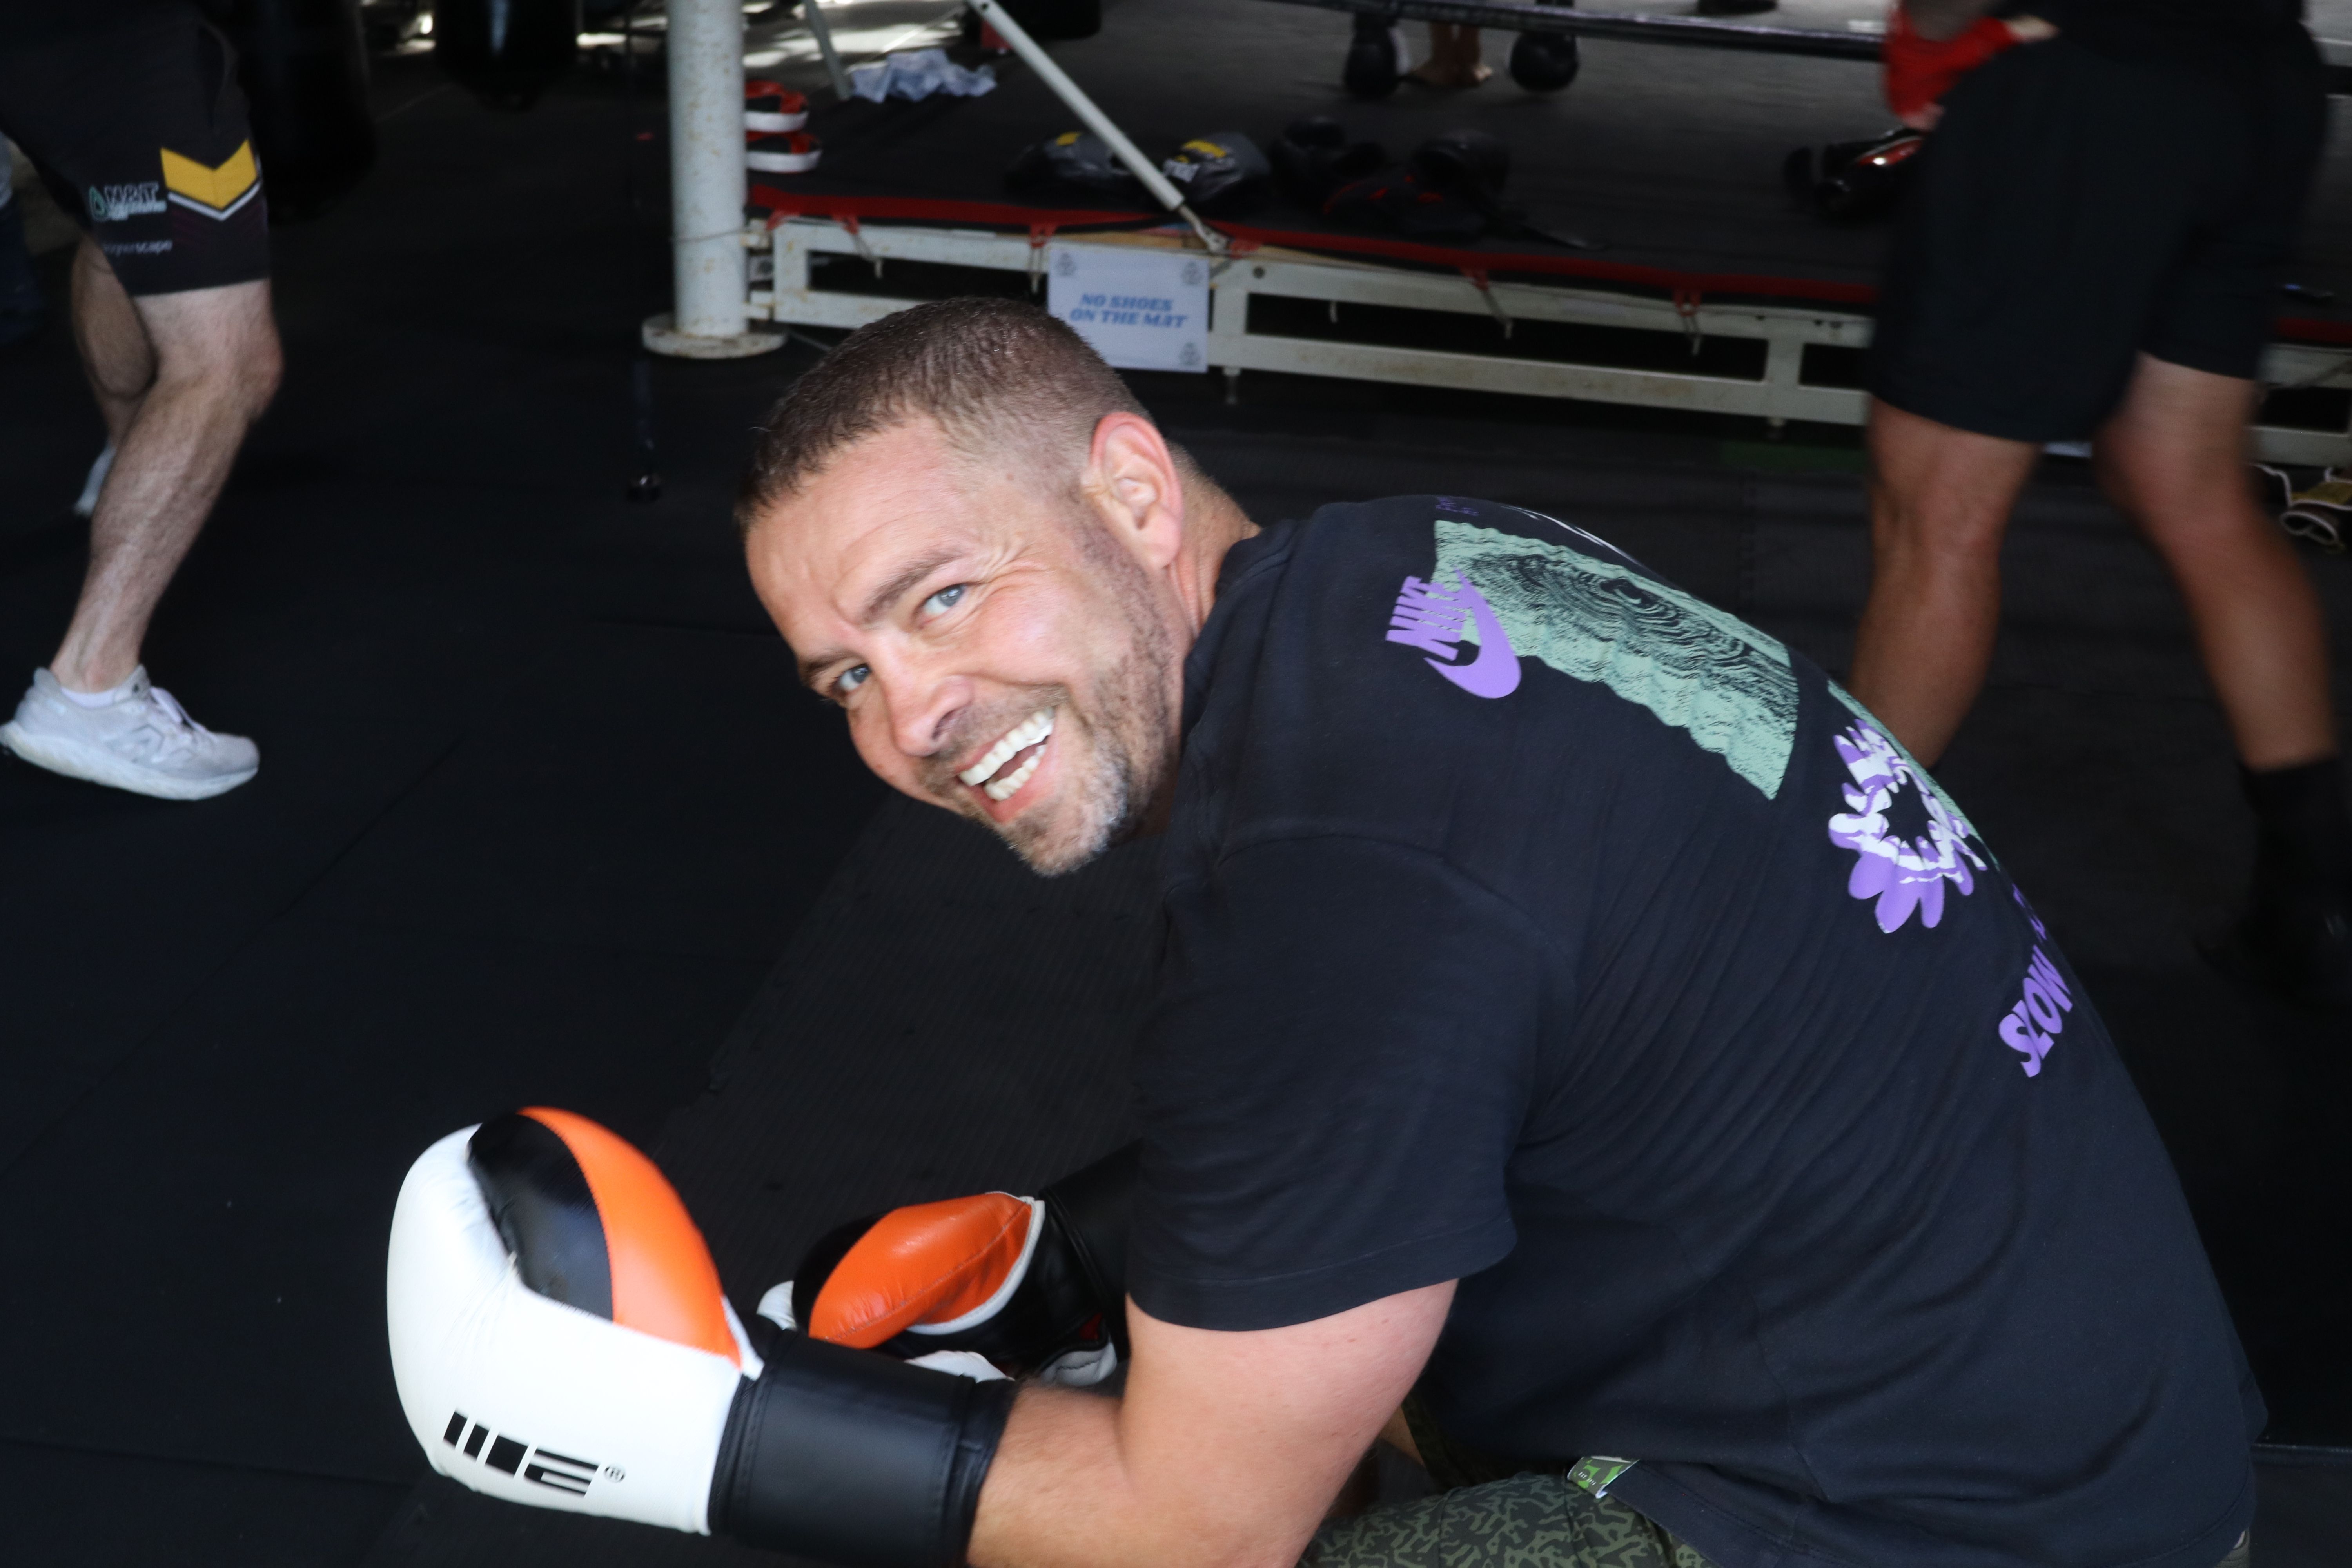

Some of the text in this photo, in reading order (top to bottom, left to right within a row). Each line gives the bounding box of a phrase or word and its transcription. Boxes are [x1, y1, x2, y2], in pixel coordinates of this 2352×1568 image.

[1070, 308, 1187, 327] ON THE MAT
[1081, 294, 1173, 311] NO SHOES
[1385, 575, 1470, 661] NIKE
[1998, 944, 2074, 1078] SLOW
